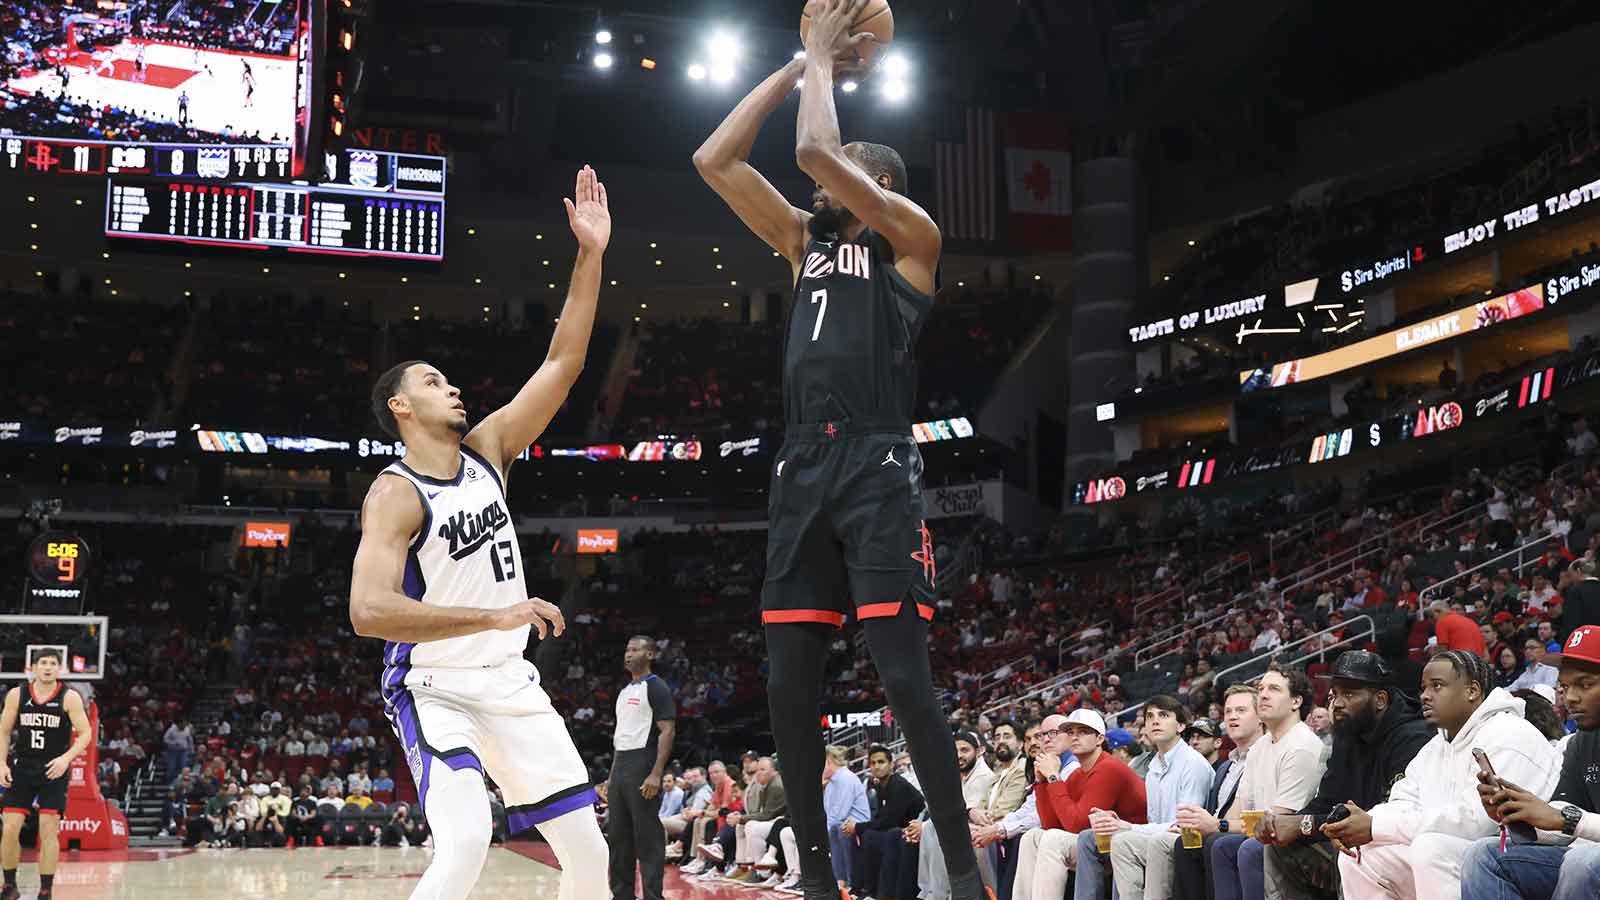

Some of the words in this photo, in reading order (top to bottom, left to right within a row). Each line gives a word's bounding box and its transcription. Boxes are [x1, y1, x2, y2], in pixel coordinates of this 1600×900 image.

[73, 146, 89, 172] 11
[1444, 219, 1497, 253] ENJOY
[1503, 204, 1539, 231] THE
[1545, 179, 1600, 215] TASTE
[1354, 269, 1373, 286] Sire
[1375, 257, 1405, 280] Spirits
[1560, 276, 1580, 295] Sire
[811, 288, 828, 342] 7
[1129, 318, 1174, 342] TASTE
[1179, 311, 1199, 330] OF
[1204, 294, 1267, 324] LUXURY
[439, 500, 508, 561] Kings
[47, 543, 78, 558] 6:06
[490, 540, 516, 582] 13
[58, 557, 75, 581] 9
[45, 589, 80, 598] TISSOT
[20, 713, 61, 728] HOUSTON
[30, 729, 45, 749] 15
[60, 815, 102, 834] finity
